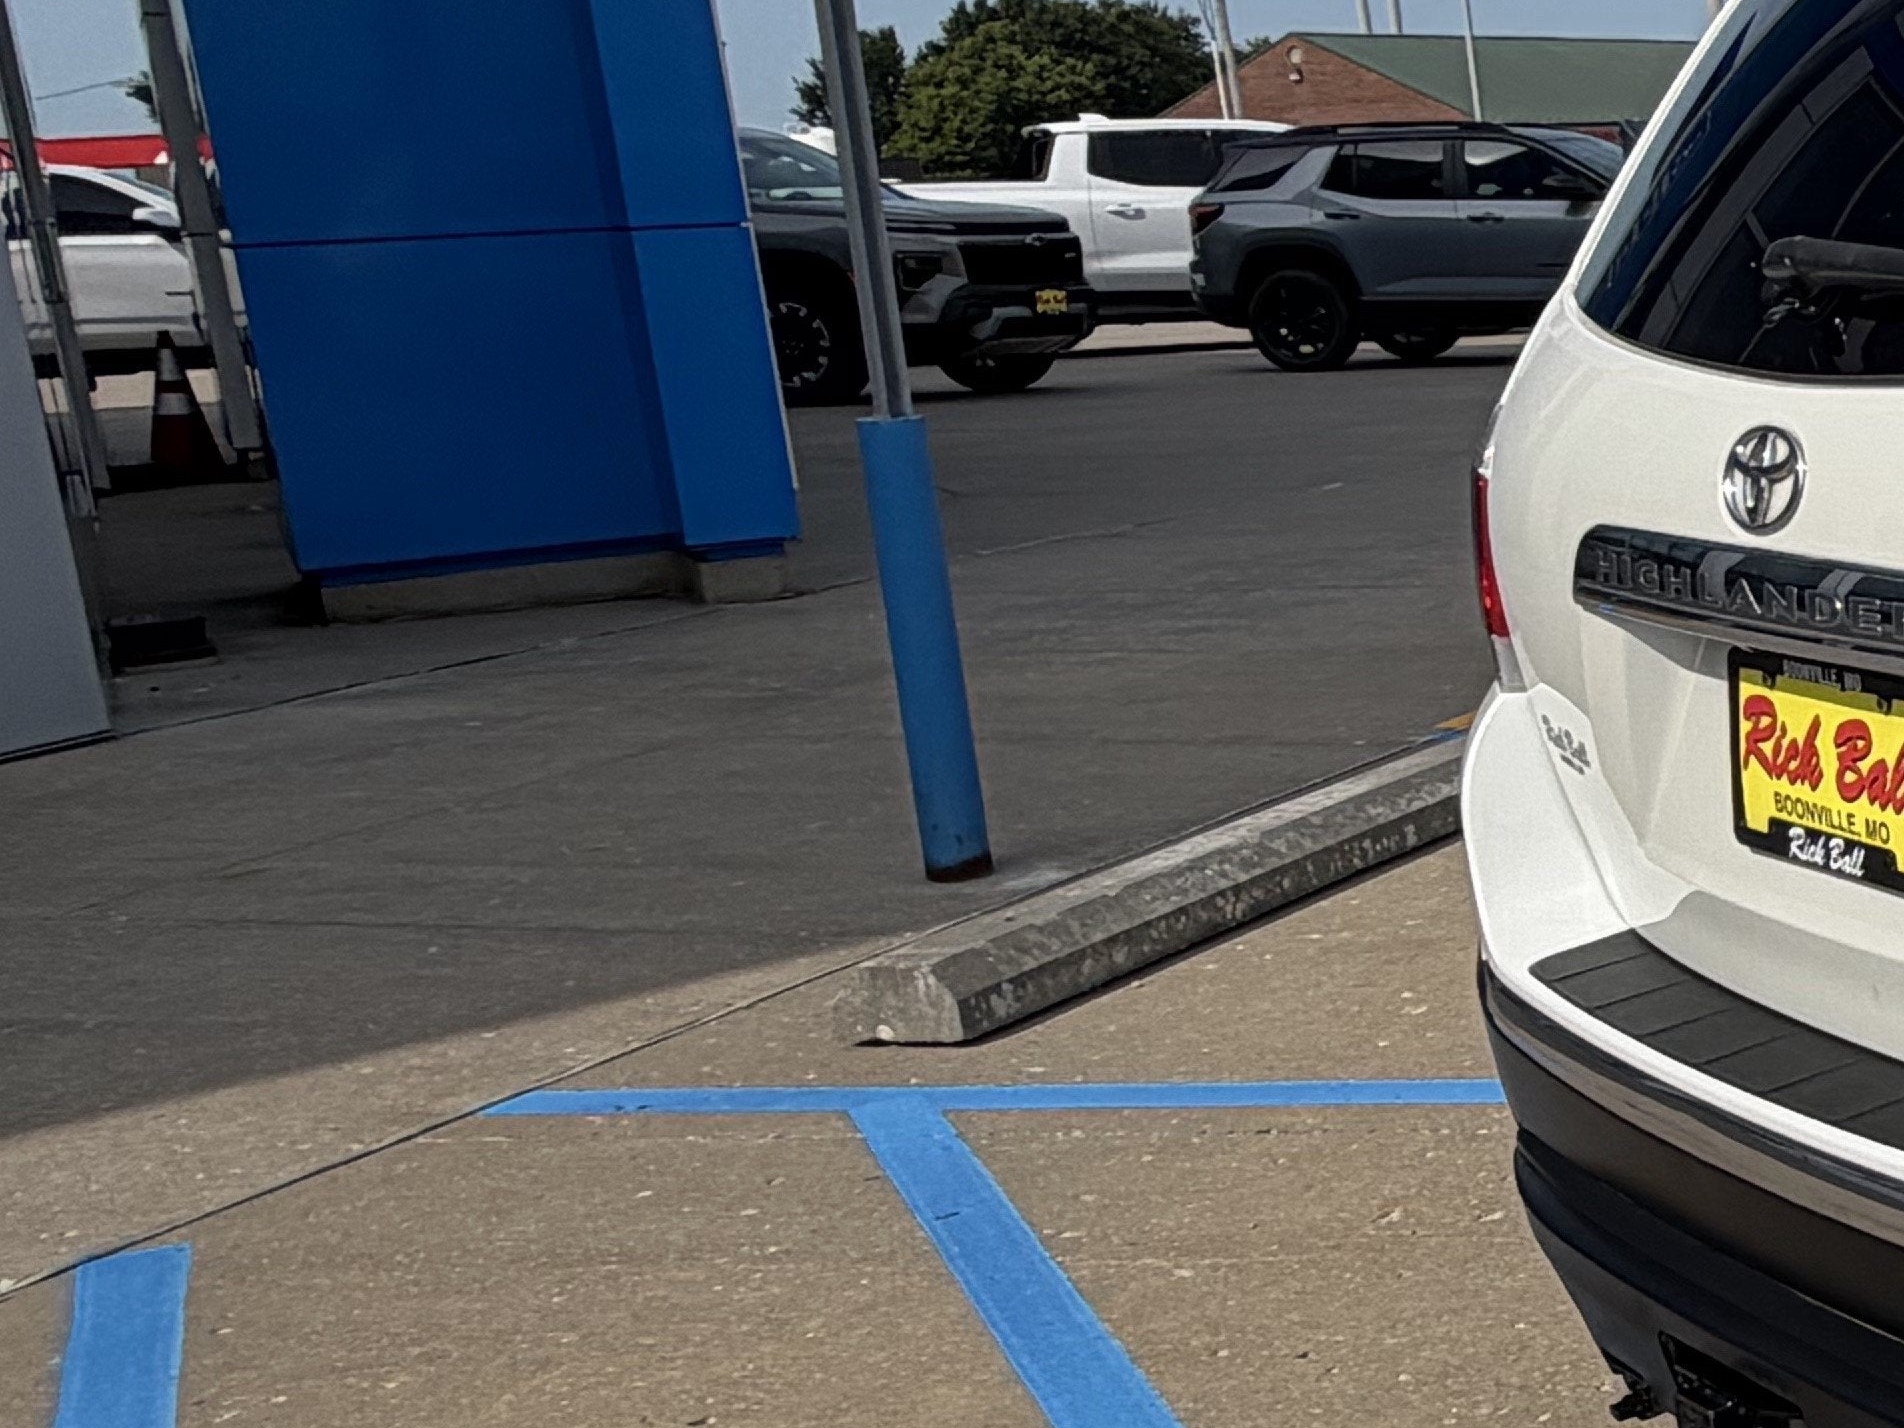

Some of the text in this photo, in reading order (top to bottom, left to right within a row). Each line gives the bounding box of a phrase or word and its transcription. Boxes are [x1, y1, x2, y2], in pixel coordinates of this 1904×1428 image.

[1743, 694, 1823, 792] Rick
[1788, 827, 1866, 877] Rick Ball
[1865, 816, 1891, 846] MO
